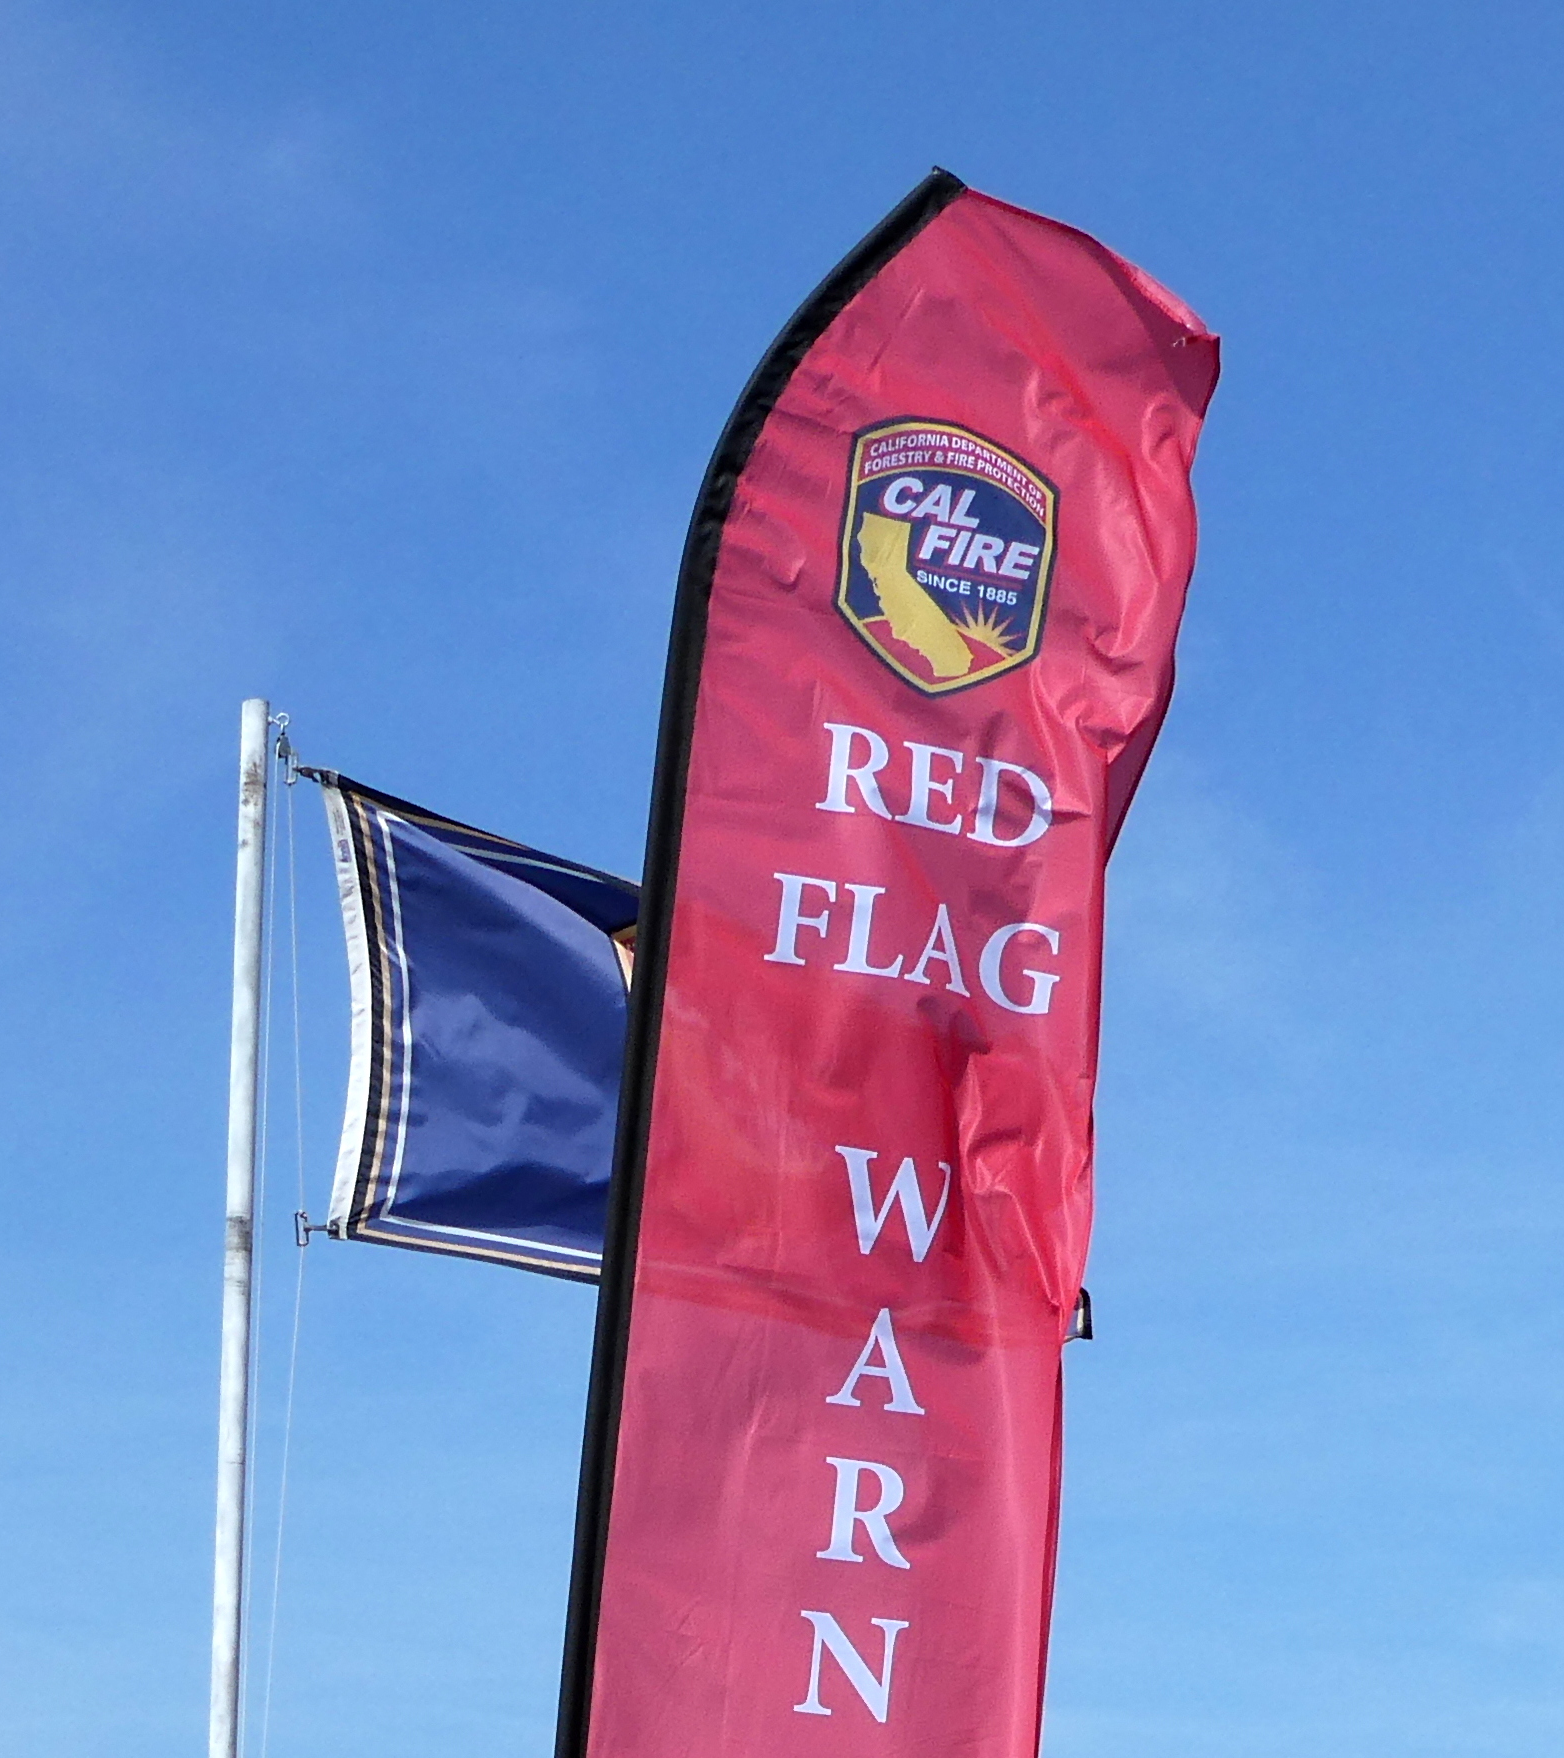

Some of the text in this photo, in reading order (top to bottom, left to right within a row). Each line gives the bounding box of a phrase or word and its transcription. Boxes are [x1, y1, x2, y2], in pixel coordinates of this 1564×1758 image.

[864, 451, 1045, 517] FORESTRY & FIRE PROTECTION
[870, 434, 1043, 500] CALIFORNIA DEPARTMENT OF
[882, 476, 980, 529] CAL
[918, 524, 1040, 580] FIRE
[916, 569, 1018, 606] SINCE 1885
[815, 722, 1052, 848] RED
[763, 872, 1060, 1015] FLAG
